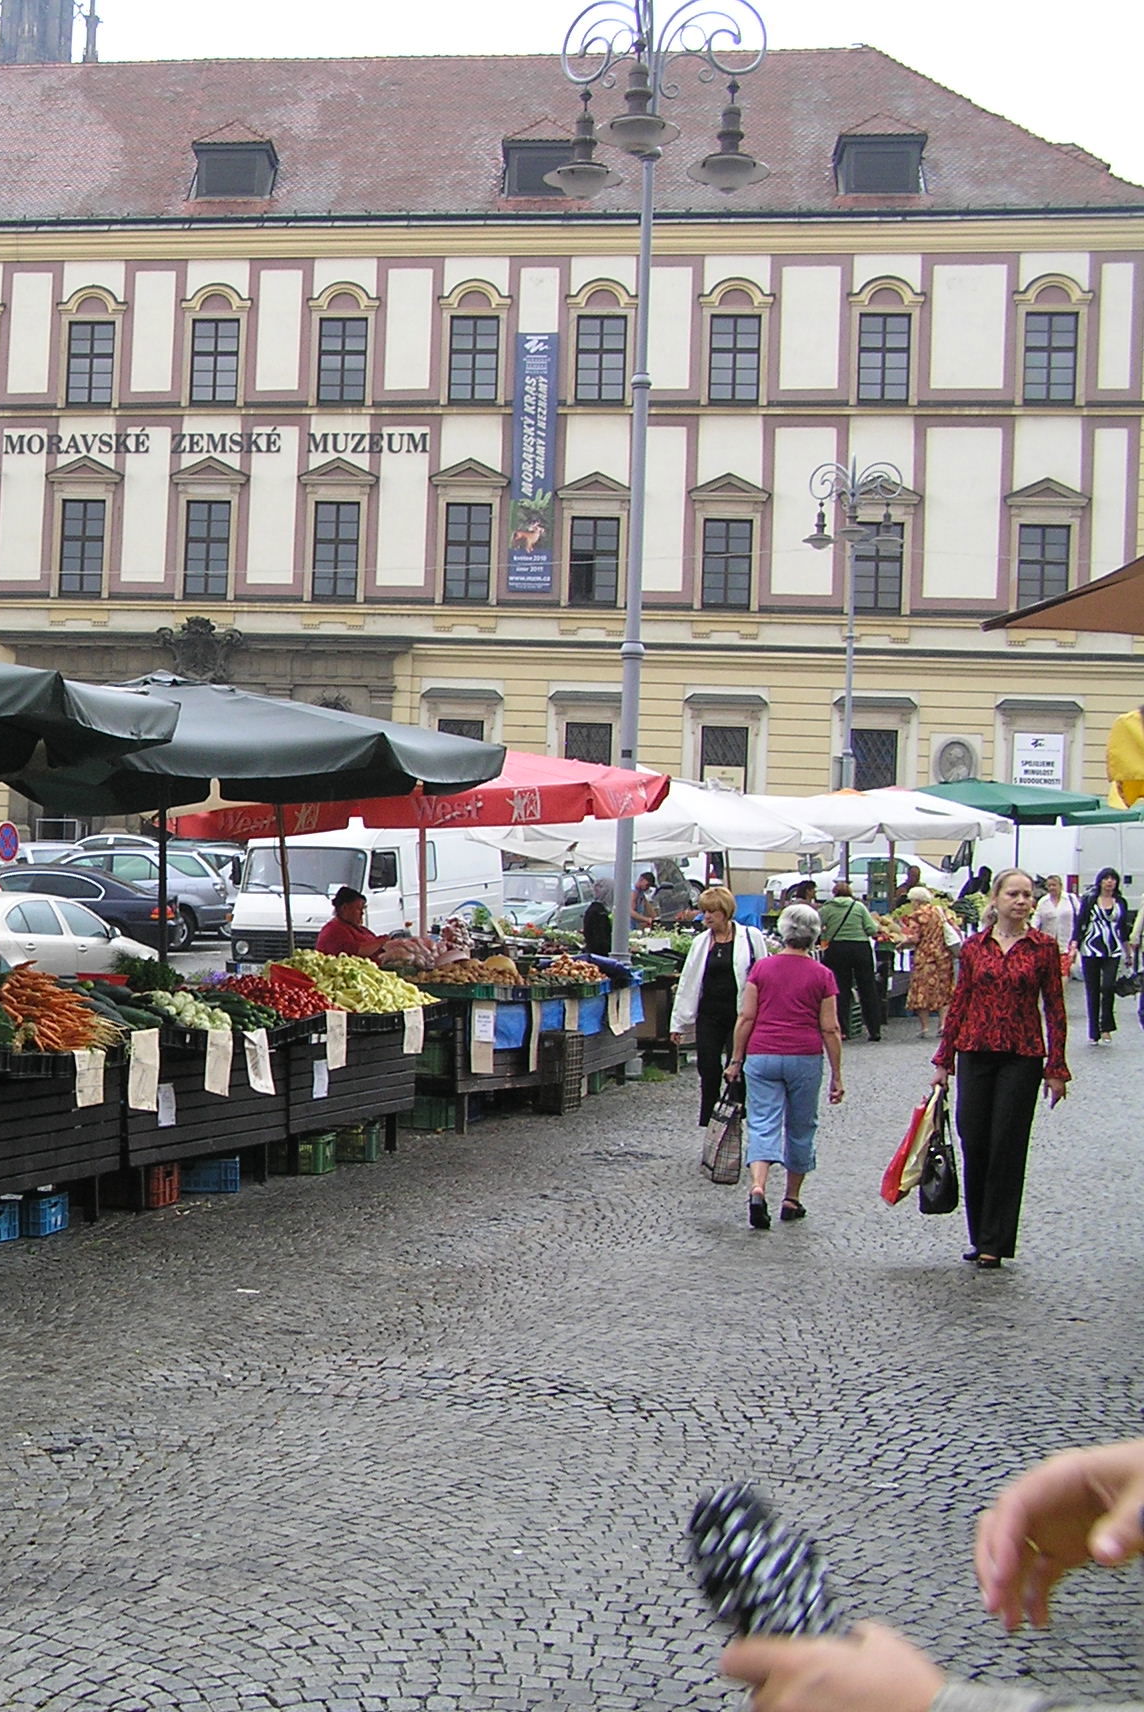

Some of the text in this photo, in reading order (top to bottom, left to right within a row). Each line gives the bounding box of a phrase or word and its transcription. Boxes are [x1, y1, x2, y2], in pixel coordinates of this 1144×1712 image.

[3, 427, 430, 455] MORAVSKÉ ZEMSKÉ MUZEUM
[520, 375, 537, 497] MORAVSKÝ KRAS
[216, 807, 277, 834] West
[410, 795, 483, 824] West
